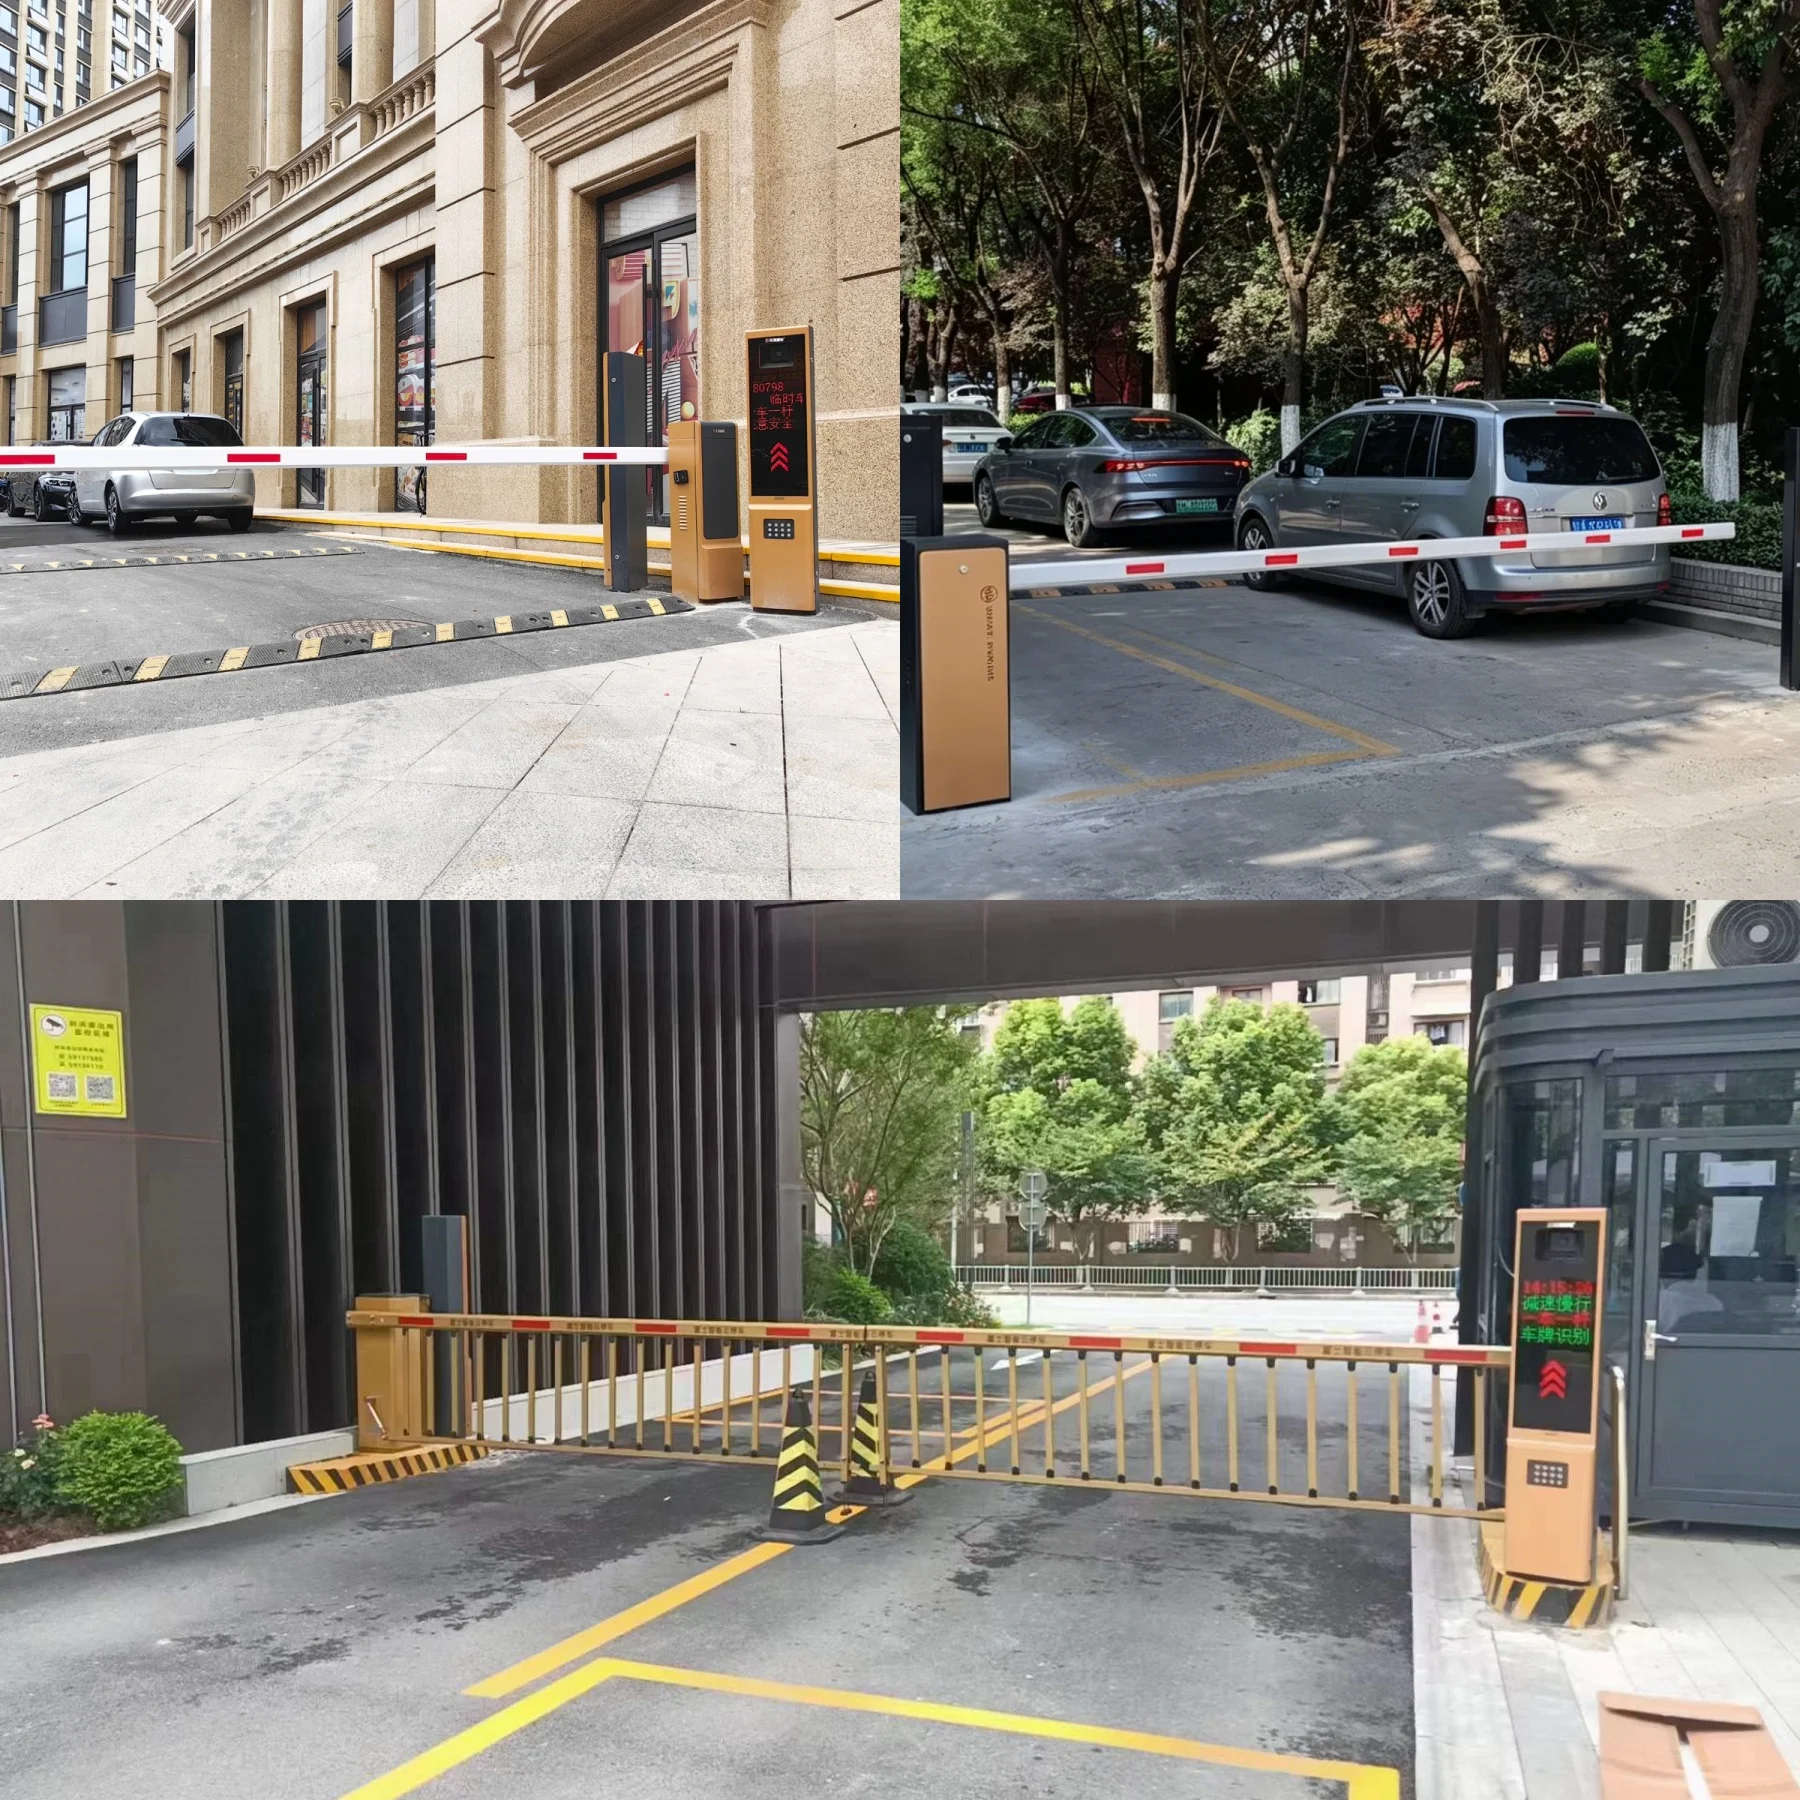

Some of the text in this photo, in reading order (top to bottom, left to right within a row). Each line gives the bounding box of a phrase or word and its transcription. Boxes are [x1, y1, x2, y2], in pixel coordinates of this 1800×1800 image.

[752, 381, 784, 393] 80798
[753, 404, 794, 417] 车一杆
[1520, 1325, 1590, 1346] 车牌识别
